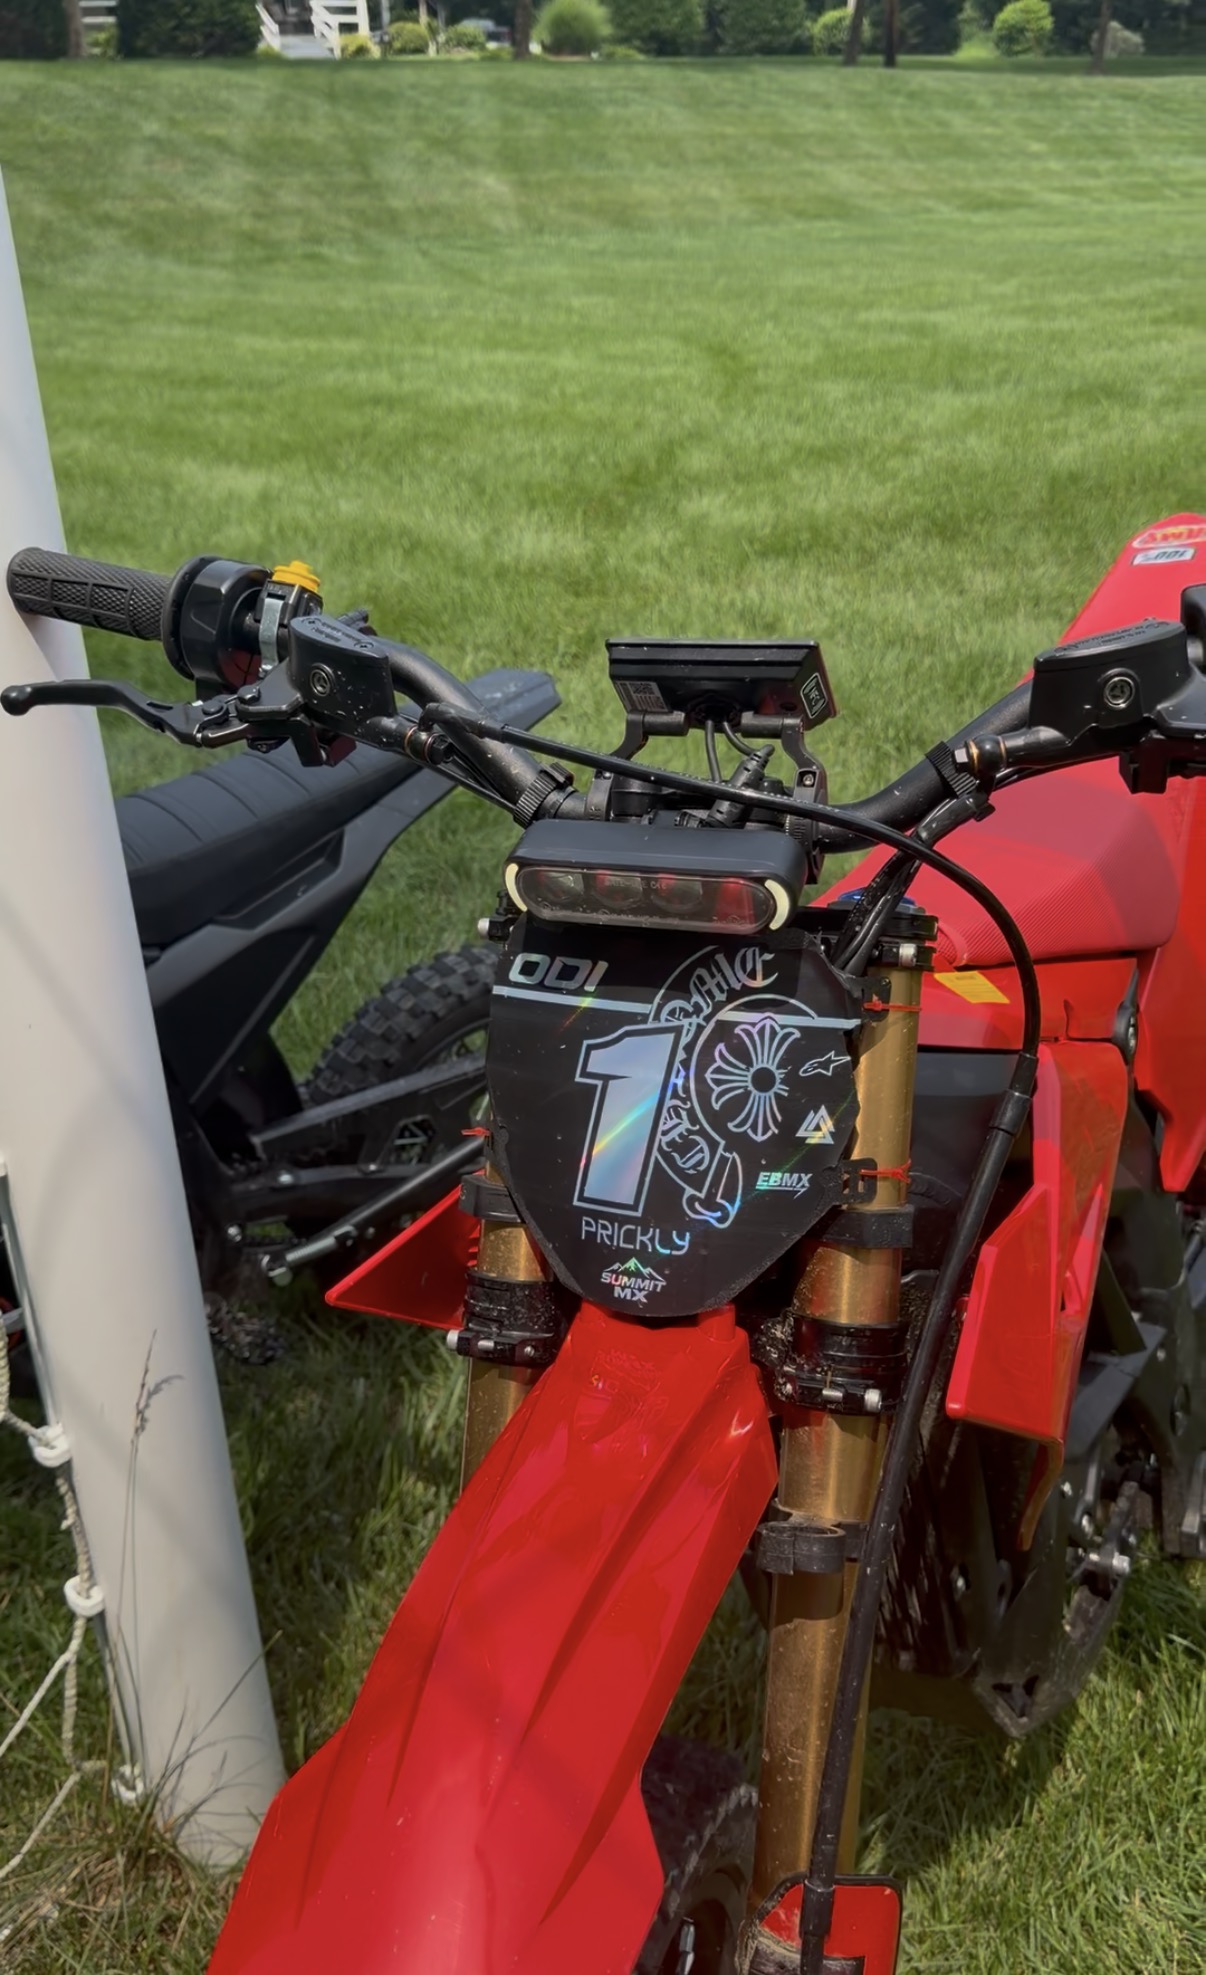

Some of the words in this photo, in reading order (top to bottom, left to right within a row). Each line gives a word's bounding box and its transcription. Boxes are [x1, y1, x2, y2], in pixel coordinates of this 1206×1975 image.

[508, 952, 609, 992] ODI
[756, 1171, 813, 1188] EBMX
[581, 1216, 691, 1255] PRICKLY
[600, 1271, 667, 1293] SUMMIT
[613, 1286, 648, 1303] MX
